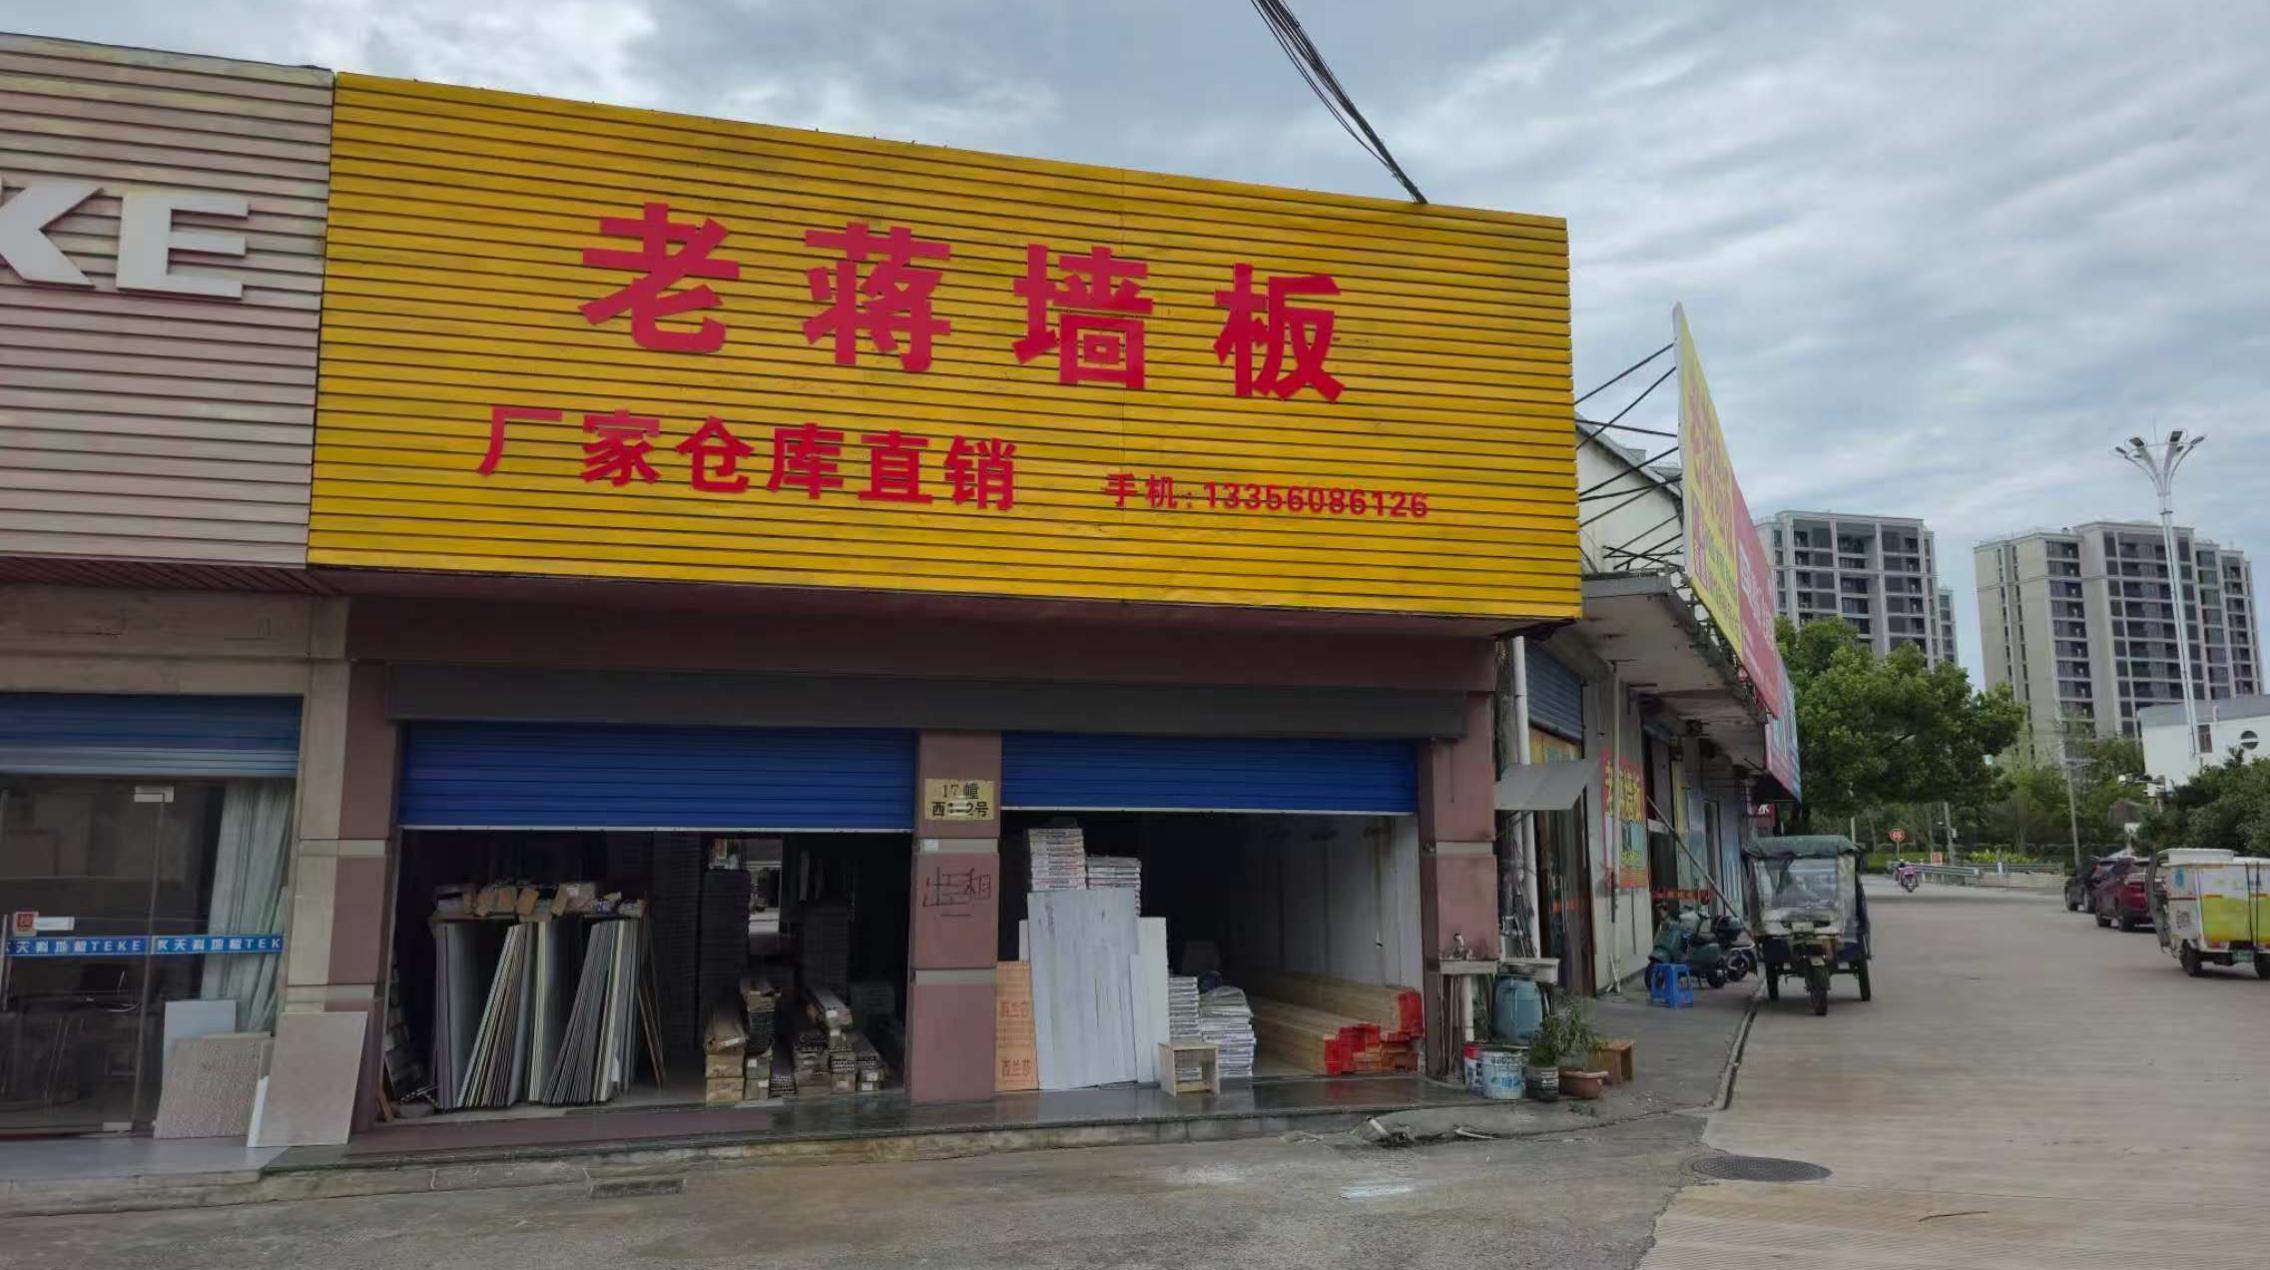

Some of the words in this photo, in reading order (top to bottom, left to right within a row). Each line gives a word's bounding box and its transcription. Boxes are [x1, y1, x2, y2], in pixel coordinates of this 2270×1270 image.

[0, 184, 250, 299] KE
[578, 202, 1345, 404] 老蒋墙板
[475, 405, 1017, 511] 厂家仓库直销
